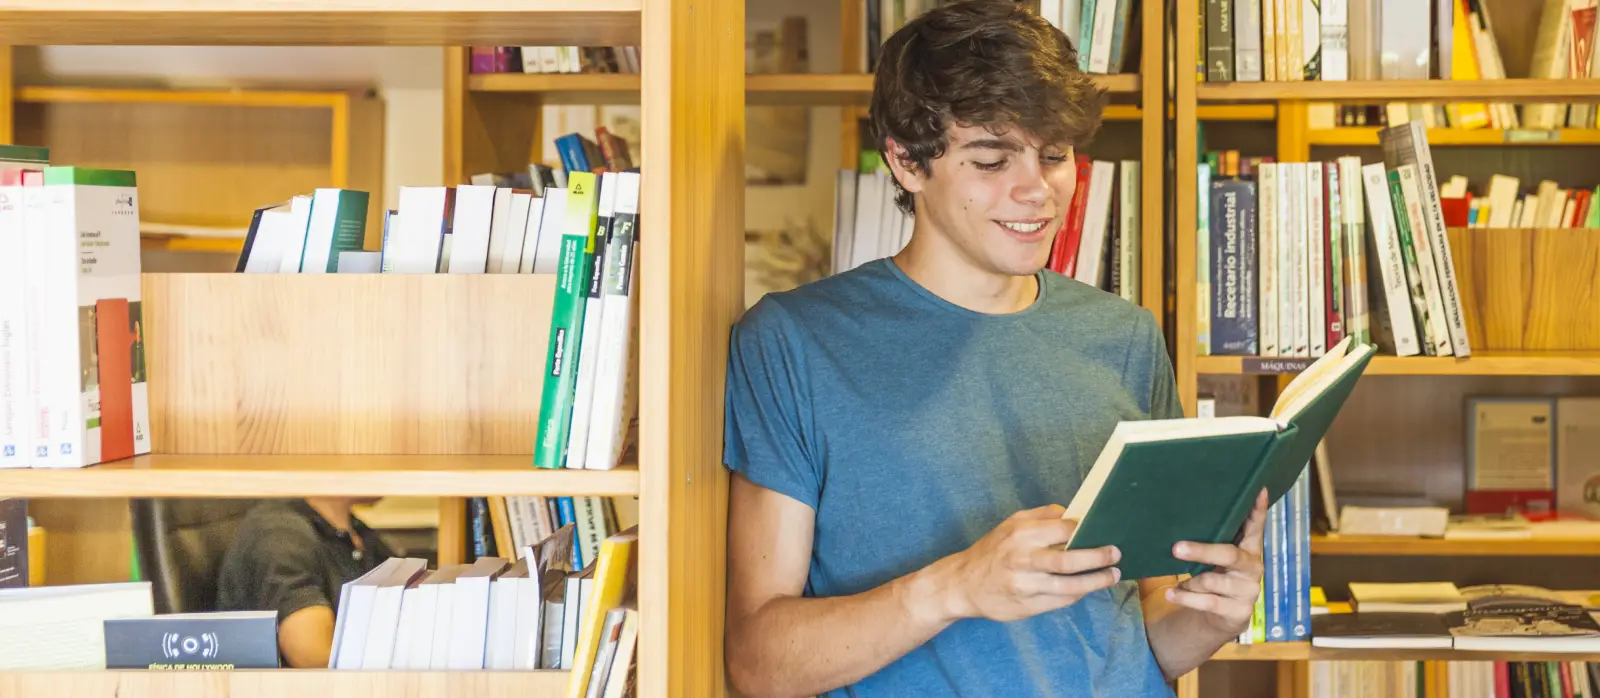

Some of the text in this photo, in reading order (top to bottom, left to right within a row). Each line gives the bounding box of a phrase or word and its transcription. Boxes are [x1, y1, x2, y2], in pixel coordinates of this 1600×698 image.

[1424, 163, 1437, 203] VELOCIDAD
[1432, 203, 1440, 221] ALTA
[1224, 192, 1236, 318] Recetario industrial
[1437, 233, 1452, 279] FERROVIARIA
[1446, 279, 1461, 330] SEÑALIZACIÓN
